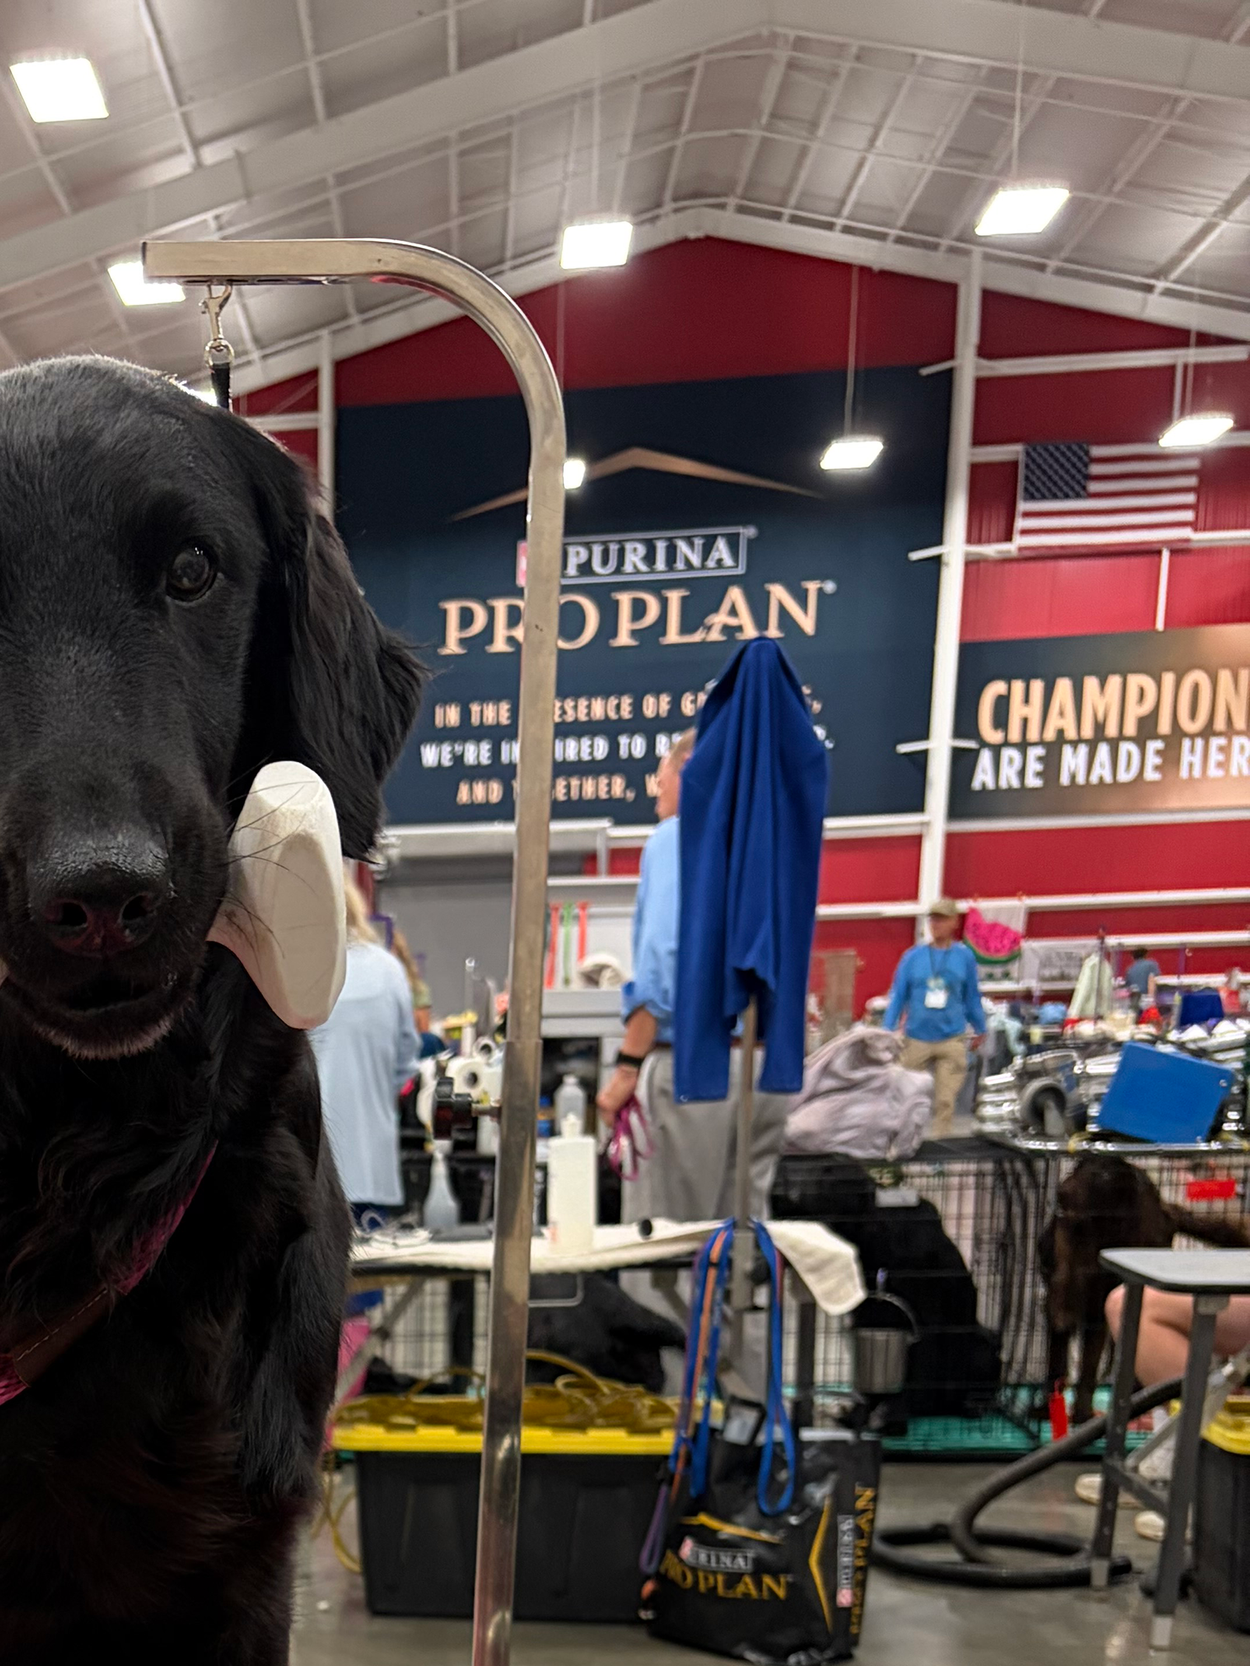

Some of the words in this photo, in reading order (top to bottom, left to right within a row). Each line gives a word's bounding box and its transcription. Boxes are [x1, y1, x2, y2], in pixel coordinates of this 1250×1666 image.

[564, 535, 735, 577] PURINA
[437, 591, 600, 656] PRO
[608, 580, 824, 647] PLAN
[434, 701, 461, 729] IN
[469, 699, 512, 727] THE
[552, 693, 634, 724] ESENCE
[642, 691, 672, 719] OF
[977, 667, 1250, 745] CHAMPION
[419, 738, 493, 768] WE'RE
[501, 732, 610, 765] INIRED
[617, 731, 648, 760] TO
[971, 745, 1047, 791] ARE
[1059, 738, 1166, 787] MADE
[456, 778, 504, 805] AND
[697, 1568, 788, 1601] PLAN
